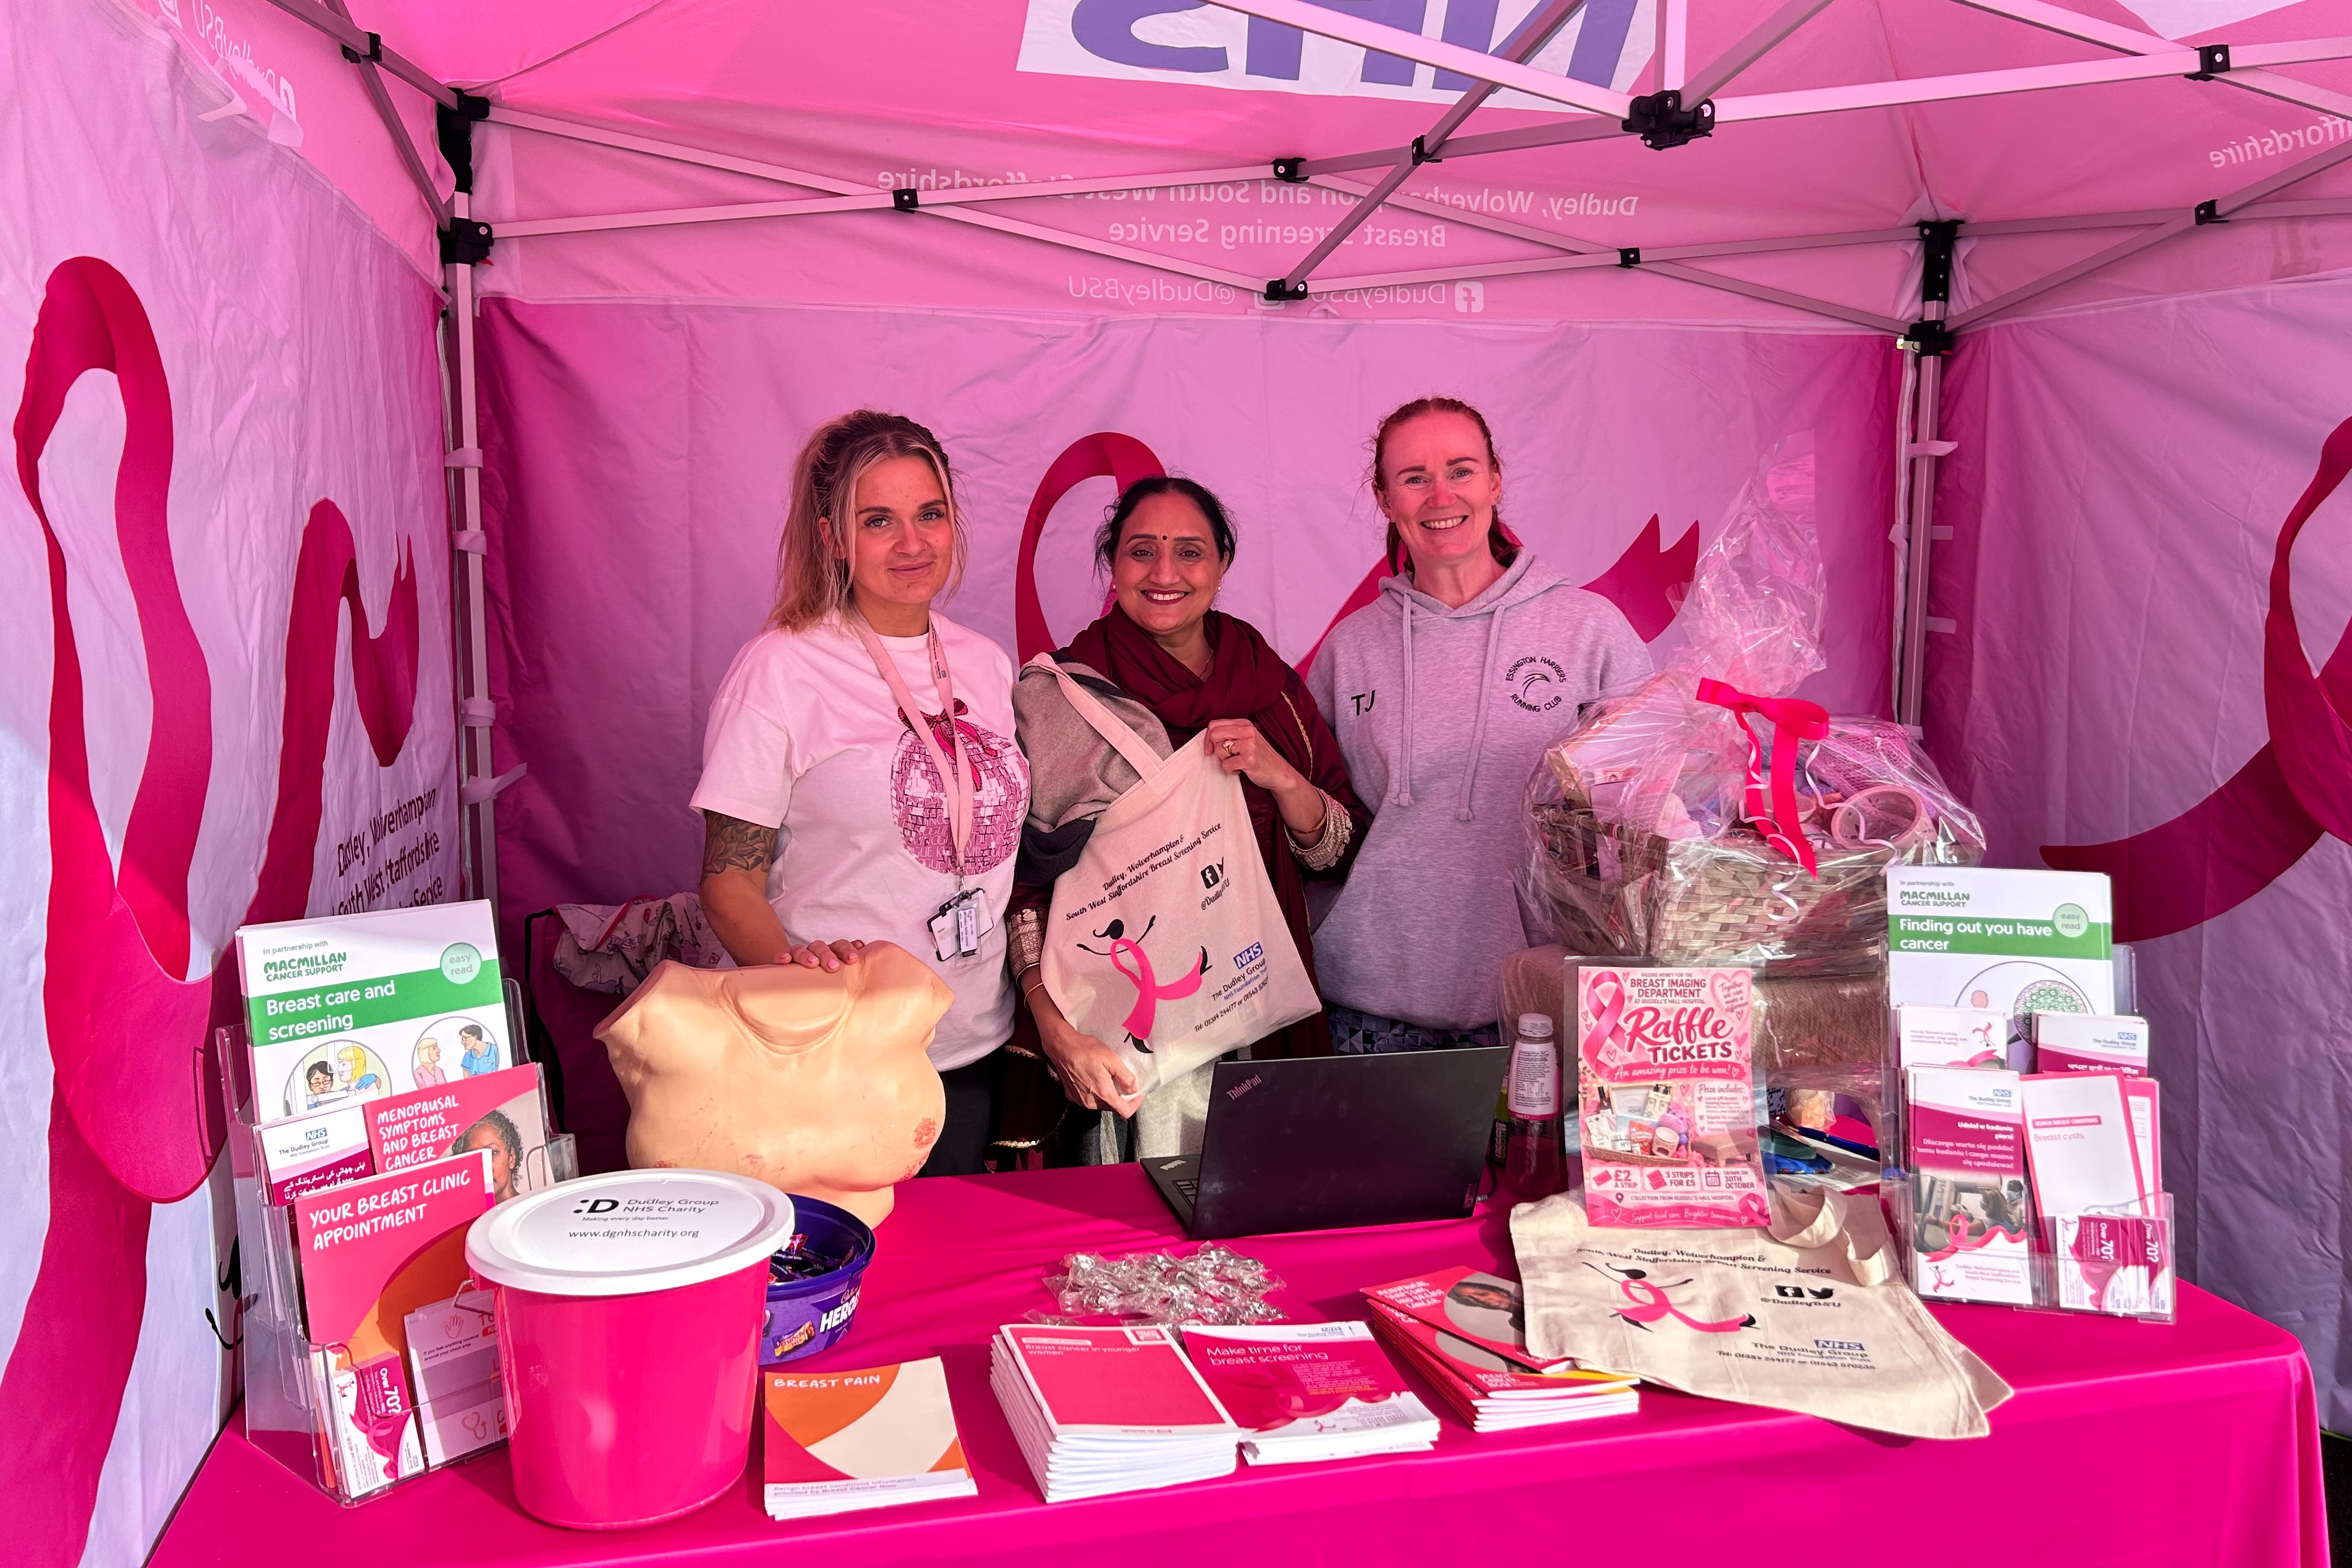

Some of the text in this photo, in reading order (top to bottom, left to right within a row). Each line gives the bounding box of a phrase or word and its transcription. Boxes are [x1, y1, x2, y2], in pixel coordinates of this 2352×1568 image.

[1506, 656, 1536, 681] ESSINGTON
[1540, 657, 1566, 683] HARRIERS
[1350, 690, 1376, 716] TJ
[1510, 693, 1541, 713] RUNNING
[1544, 695, 1562, 711] CLUB
[337, 830, 370, 877] Dudley,
[1066, 822, 1222, 921] South West Staffordshire Breast Screening Service
[1102, 837, 1180, 891] Dudley, Wolverhampton
[1899, 890, 1970, 902] MACMILLAN
[1901, 899, 1967, 908] CANCER SUPPORT
[2060, 913, 2080, 922] easy
[2061, 922, 2081, 930] read
[1899, 918, 2053, 937] Finding out you have
[272, 942, 313, 956] partnership
[314, 939, 328, 948] with
[1899, 939, 1949, 951] cancer
[263, 951, 347, 974] MACMILLAN
[449, 954, 471, 965] easy
[1233, 942, 1264, 970] NHS
[266, 963, 344, 982] CANCER SUPPORT
[450, 964, 473, 977] read
[1211, 958, 1266, 1001] The Dudley Group
[1224, 973, 1261, 1001] NHS Foundation
[1630, 978, 1707, 988] BREAST IMAGING
[1719, 981, 1744, 993] Together
[266, 980, 396, 1016] Breast care and
[1219, 986, 1258, 1017] 244177 01543
[1637, 988, 1701, 998] DEPARTMENT
[1724, 1001, 1749, 1013] difference
[268, 1013, 354, 1040] screening
[1623, 1006, 1734, 1053] Raffle
[1647, 1041, 1732, 1063] TICKETS
[1614, 1063, 1730, 1080] An amazing prize to be won!
[1226, 1073, 1262, 1101] ThinkPad
[1697, 1083, 1716, 1094] Prize
[1993, 1088, 2011, 1097] NHS
[377, 1095, 460, 1125] MENOPAUSAL
[306, 1128, 327, 1142] NHS
[379, 1112, 446, 1140] SYMPTOMS
[290, 1143, 310, 1153] Dudley
[311, 1139, 329, 1147] Group
[382, 1124, 460, 1155] AND BREAST
[2033, 1133, 2085, 1142] Breast cysts
[385, 1146, 437, 1171] CANCER
[1614, 1169, 1632, 1182] £2
[309, 1203, 354, 1230] YOUR
[357, 1184, 418, 1215] BREAST
[422, 1168, 470, 1196] CLINIC
[313, 1203, 428, 1251] APPOINTMENT
[569, 1228, 699, 1238] www.dgnhscharity.org
[1673, 1250, 1755, 1262] Wolverhampton
[2146, 1241, 2160, 1262] 70?
[1606, 1251, 1632, 1261] West
[1635, 1255, 1702, 1264] Staffordshire
[1741, 1263, 1791, 1273] Screening
[1206, 1343, 1303, 1357] Make time for
[1752, 1342, 1868, 1359] The Dudley Group
[1815, 1340, 1864, 1350] NHS
[1210, 1351, 1329, 1366] breast screening
[774, 1374, 881, 1388] BREAST PAIN
[380, 1367, 402, 1415] Over 70?
